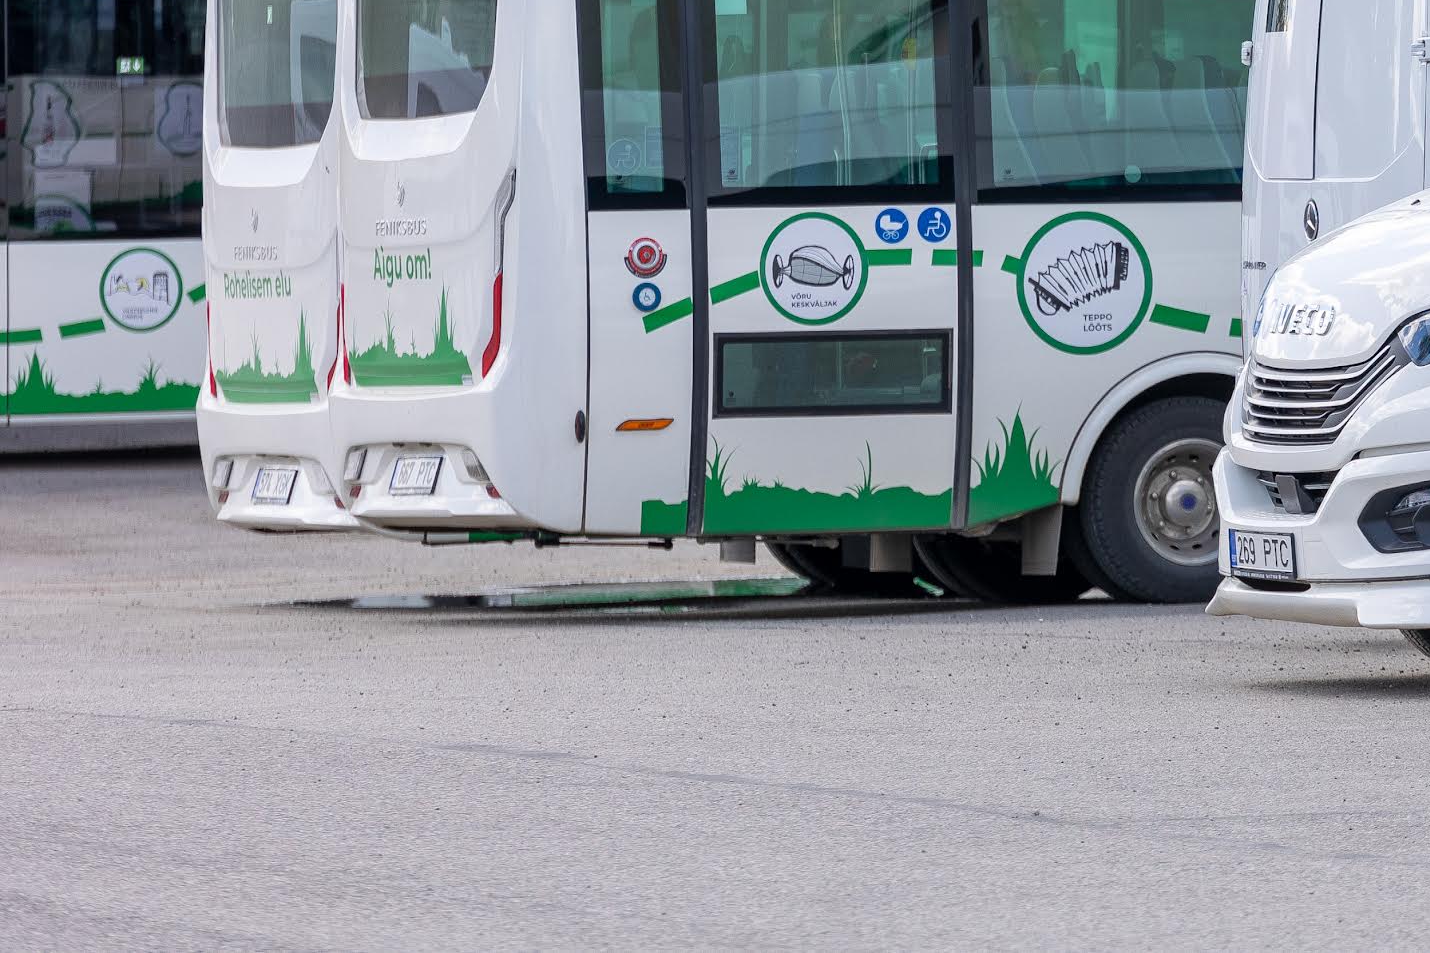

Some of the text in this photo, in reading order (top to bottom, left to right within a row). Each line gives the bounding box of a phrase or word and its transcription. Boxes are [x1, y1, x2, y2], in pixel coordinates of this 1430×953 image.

[375, 219, 427, 237] FENIKSBUS
[373, 245, 432, 288] Aigu om!
[223, 270, 292, 300] Rohelisem elu
[791, 292, 812, 300] VÕRU
[791, 300, 838, 309] KESKVÄLJAK
[1083, 313, 1113, 322] TEPPO
[1269, 300, 1336, 337] IVECO
[415, 461, 436, 485] PTC
[1237, 534, 1289, 568] 269 PTC
